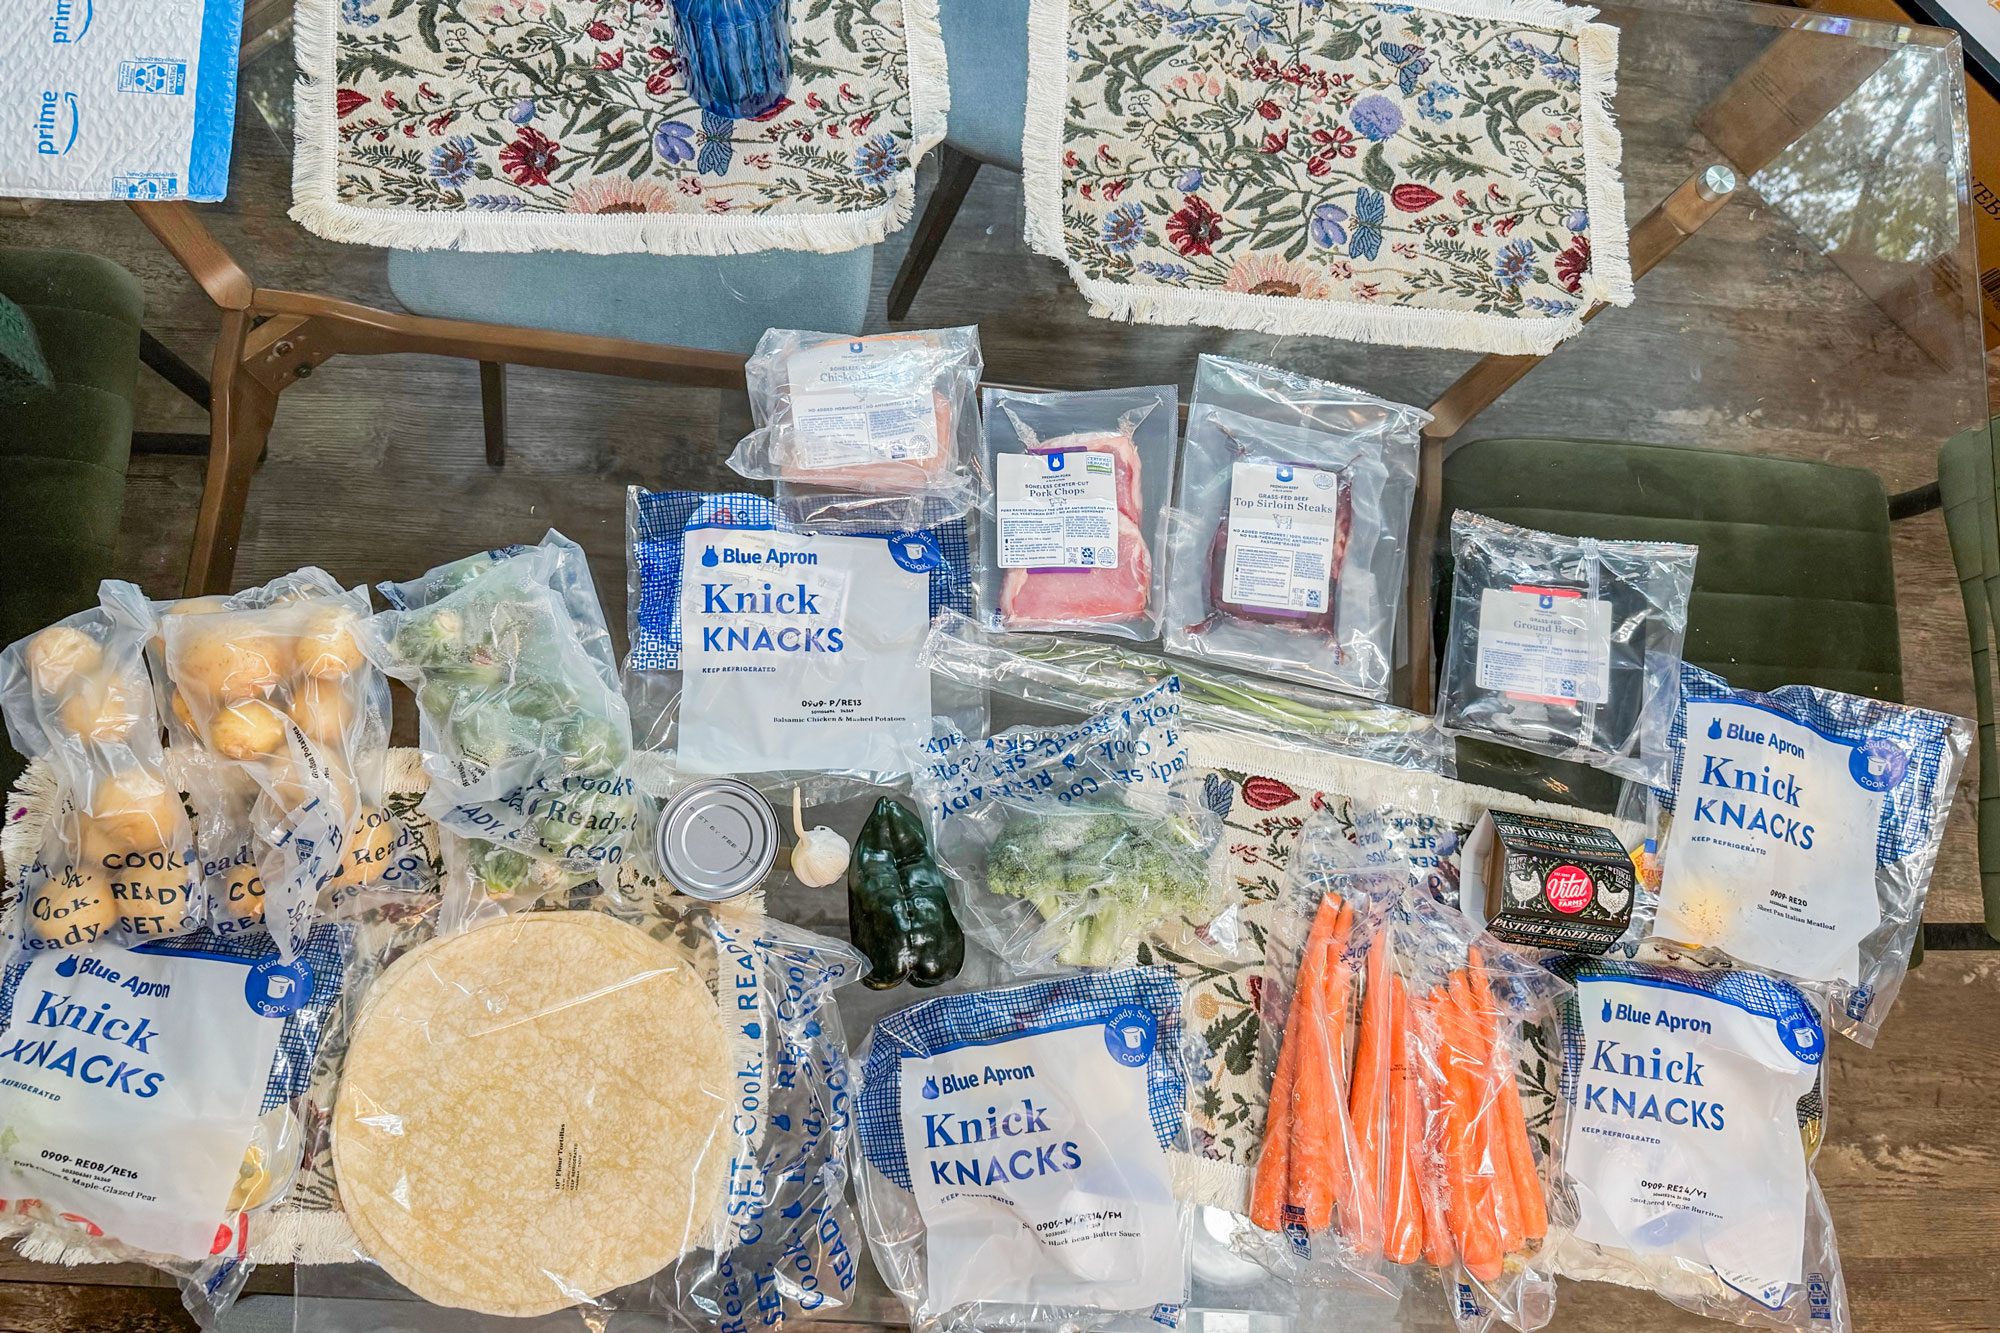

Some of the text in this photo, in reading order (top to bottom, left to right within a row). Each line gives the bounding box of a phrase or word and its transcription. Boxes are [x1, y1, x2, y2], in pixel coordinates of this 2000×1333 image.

[53, 0, 72, 44] prim
[37, 90, 58, 155] prime
[1972, 176, 2000, 220] EB
[1029, 487, 1085, 498] Pork Chops
[1233, 496, 1333, 514] Top Sirloin Steaks
[1258, 493, 1293, 501] GRASS-FED
[723, 549, 818, 567] Blue Apron
[700, 583, 820, 616] Knick
[702, 626, 844, 653] KNACKS
[1513, 619, 1578, 635] Ground Beef
[829, 698, 862, 707] P/RE13
[292, 726, 312, 759] Potatoes
[1726, 723, 1805, 760] Blue Apron
[1699, 754, 1803, 808] Knick
[1860, 776, 1889, 789] COOK.
[1694, 797, 1815, 850] KNACKS
[1527, 828, 1623, 851] PASTURE-RAISED
[1691, 836, 1767, 856] KEEP REFRIGERATED
[102, 851, 189, 872] COOK.
[1508, 856, 1527, 865] HAPPY
[110, 881, 202, 907] READY.
[1548, 873, 1588, 900] Vital
[1769, 889, 1787, 899] 0909-
[1558, 899, 1583, 908] FARMS
[1757, 903, 1775, 914] Sheet
[1776, 909, 1785, 918] Pan
[1785, 912, 1805, 924] Italian
[1806, 916, 1836, 931] Meatloaf
[119, 915, 174, 935] SET.
[1492, 917, 1589, 941] PASTURE-RAISED
[1587, 932, 1617, 943] EGGS
[79, 957, 171, 999] Blue Apron
[717, 928, 760, 1011] READY.
[257, 999, 291, 1014] COOK.
[1107, 1008, 1152, 1029] Ready. Set.
[1615, 1003, 1712, 1035] Blue Apron
[26, 989, 159, 1055] Knick
[1, 1039, 165, 1099] KNACKS
[1121, 1051, 1148, 1063] COOK.
[1589, 1039, 1706, 1087] Knick
[1795, 1050, 1822, 1061] COOK.
[1, 1078, 61, 1102] REFRIGERATED
[942, 1063, 1035, 1095] Blue Apron
[732, 1051, 763, 1137] Cook.
[1583, 1083, 1726, 1131] KNACKS
[922, 1099, 1051, 1149] Knick
[1581, 1126, 1661, 1145] KEEP REFRIGERATED
[557, 1123, 566, 1156] Tortillas
[41, 1150, 139, 1180] 0909- RE08/RE16
[931, 1141, 1083, 1187] KNACKS
[14, 1159, 35, 1170] Pork
[72, 1177, 135, 1200] Maple-Glazed
[136, 1188, 157, 1202] Pear
[727, 1149, 755, 1218] SET.
[940, 1192, 960, 1204] KEEP
[1048, 1237, 1069, 1247] Black
[1118, 1230, 1141, 1239] Sauce
[783, 1226, 825, 1312] Cook.
[754, 1259, 787, 1327] SET.
